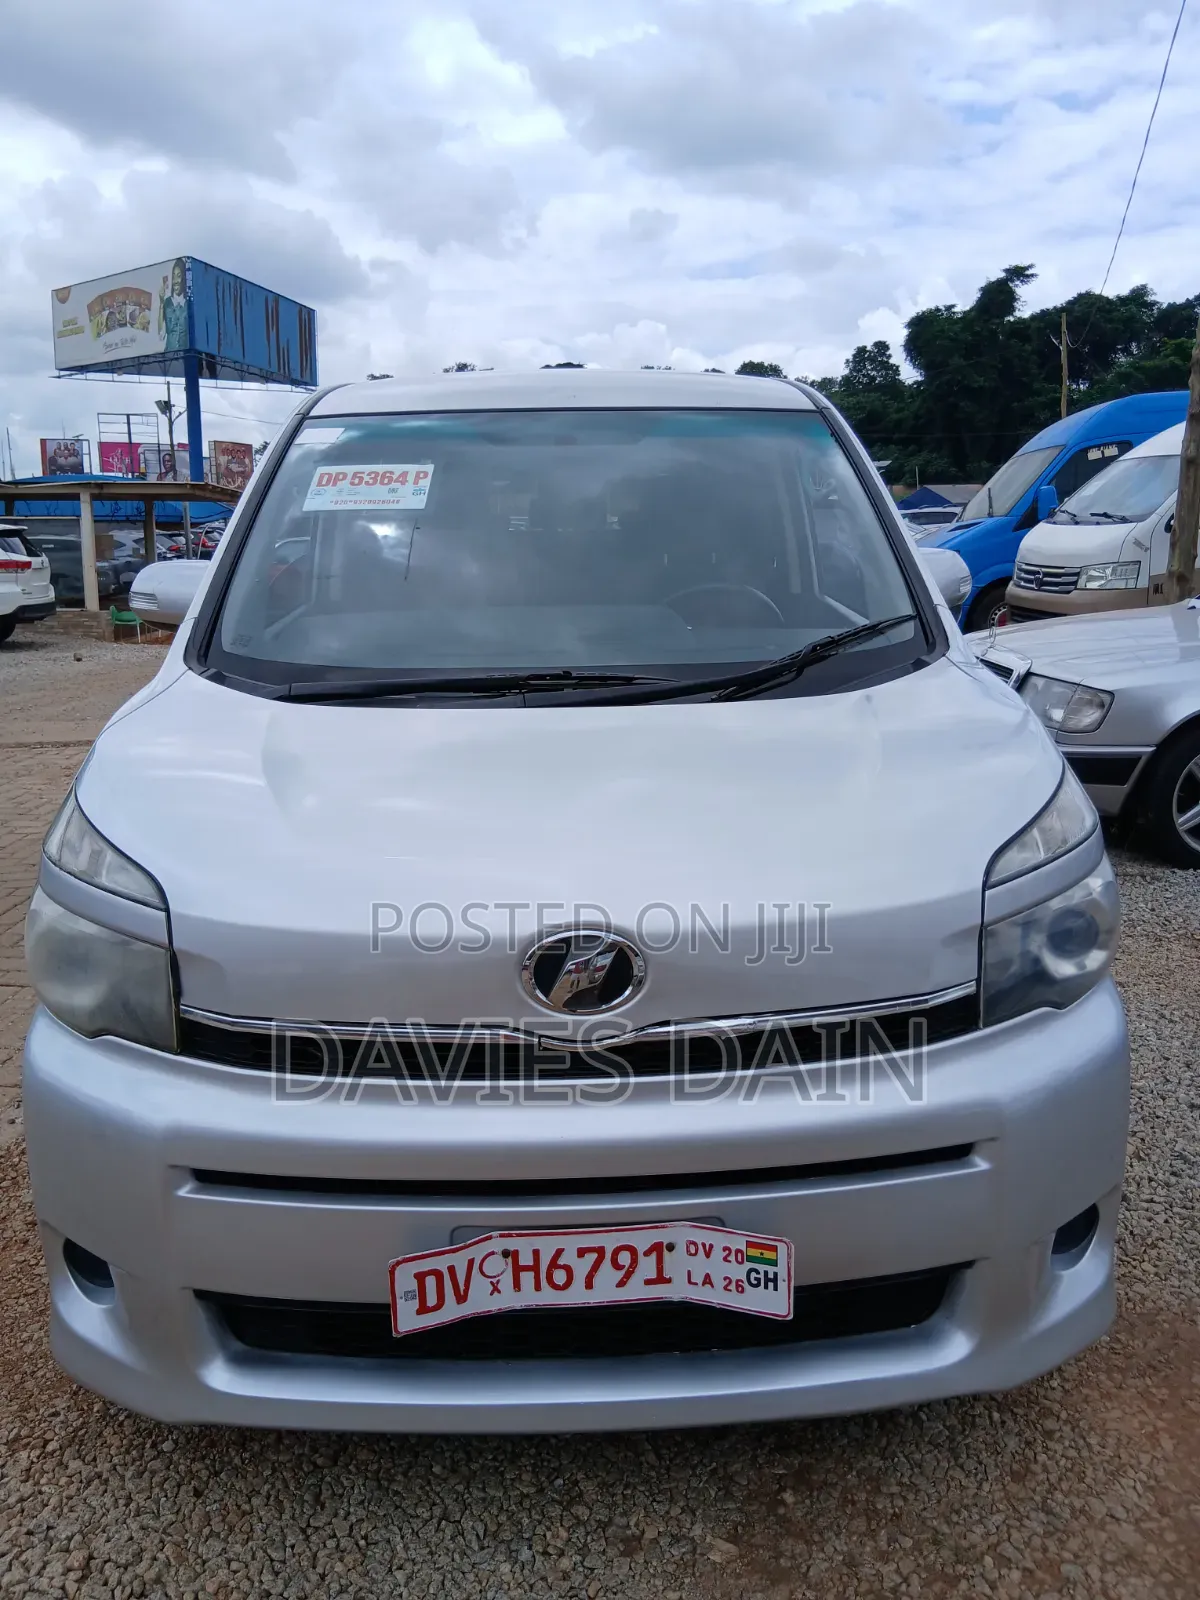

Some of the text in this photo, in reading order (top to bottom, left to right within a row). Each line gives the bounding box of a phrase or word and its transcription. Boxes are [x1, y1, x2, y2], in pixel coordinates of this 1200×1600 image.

[316, 470, 429, 487] DP 5364 P
[686, 1239, 745, 1265] DV 20
[413, 1240, 672, 1316] DV H6791
[687, 1269, 745, 1295] LA 26
[745, 1267, 779, 1292] GH
